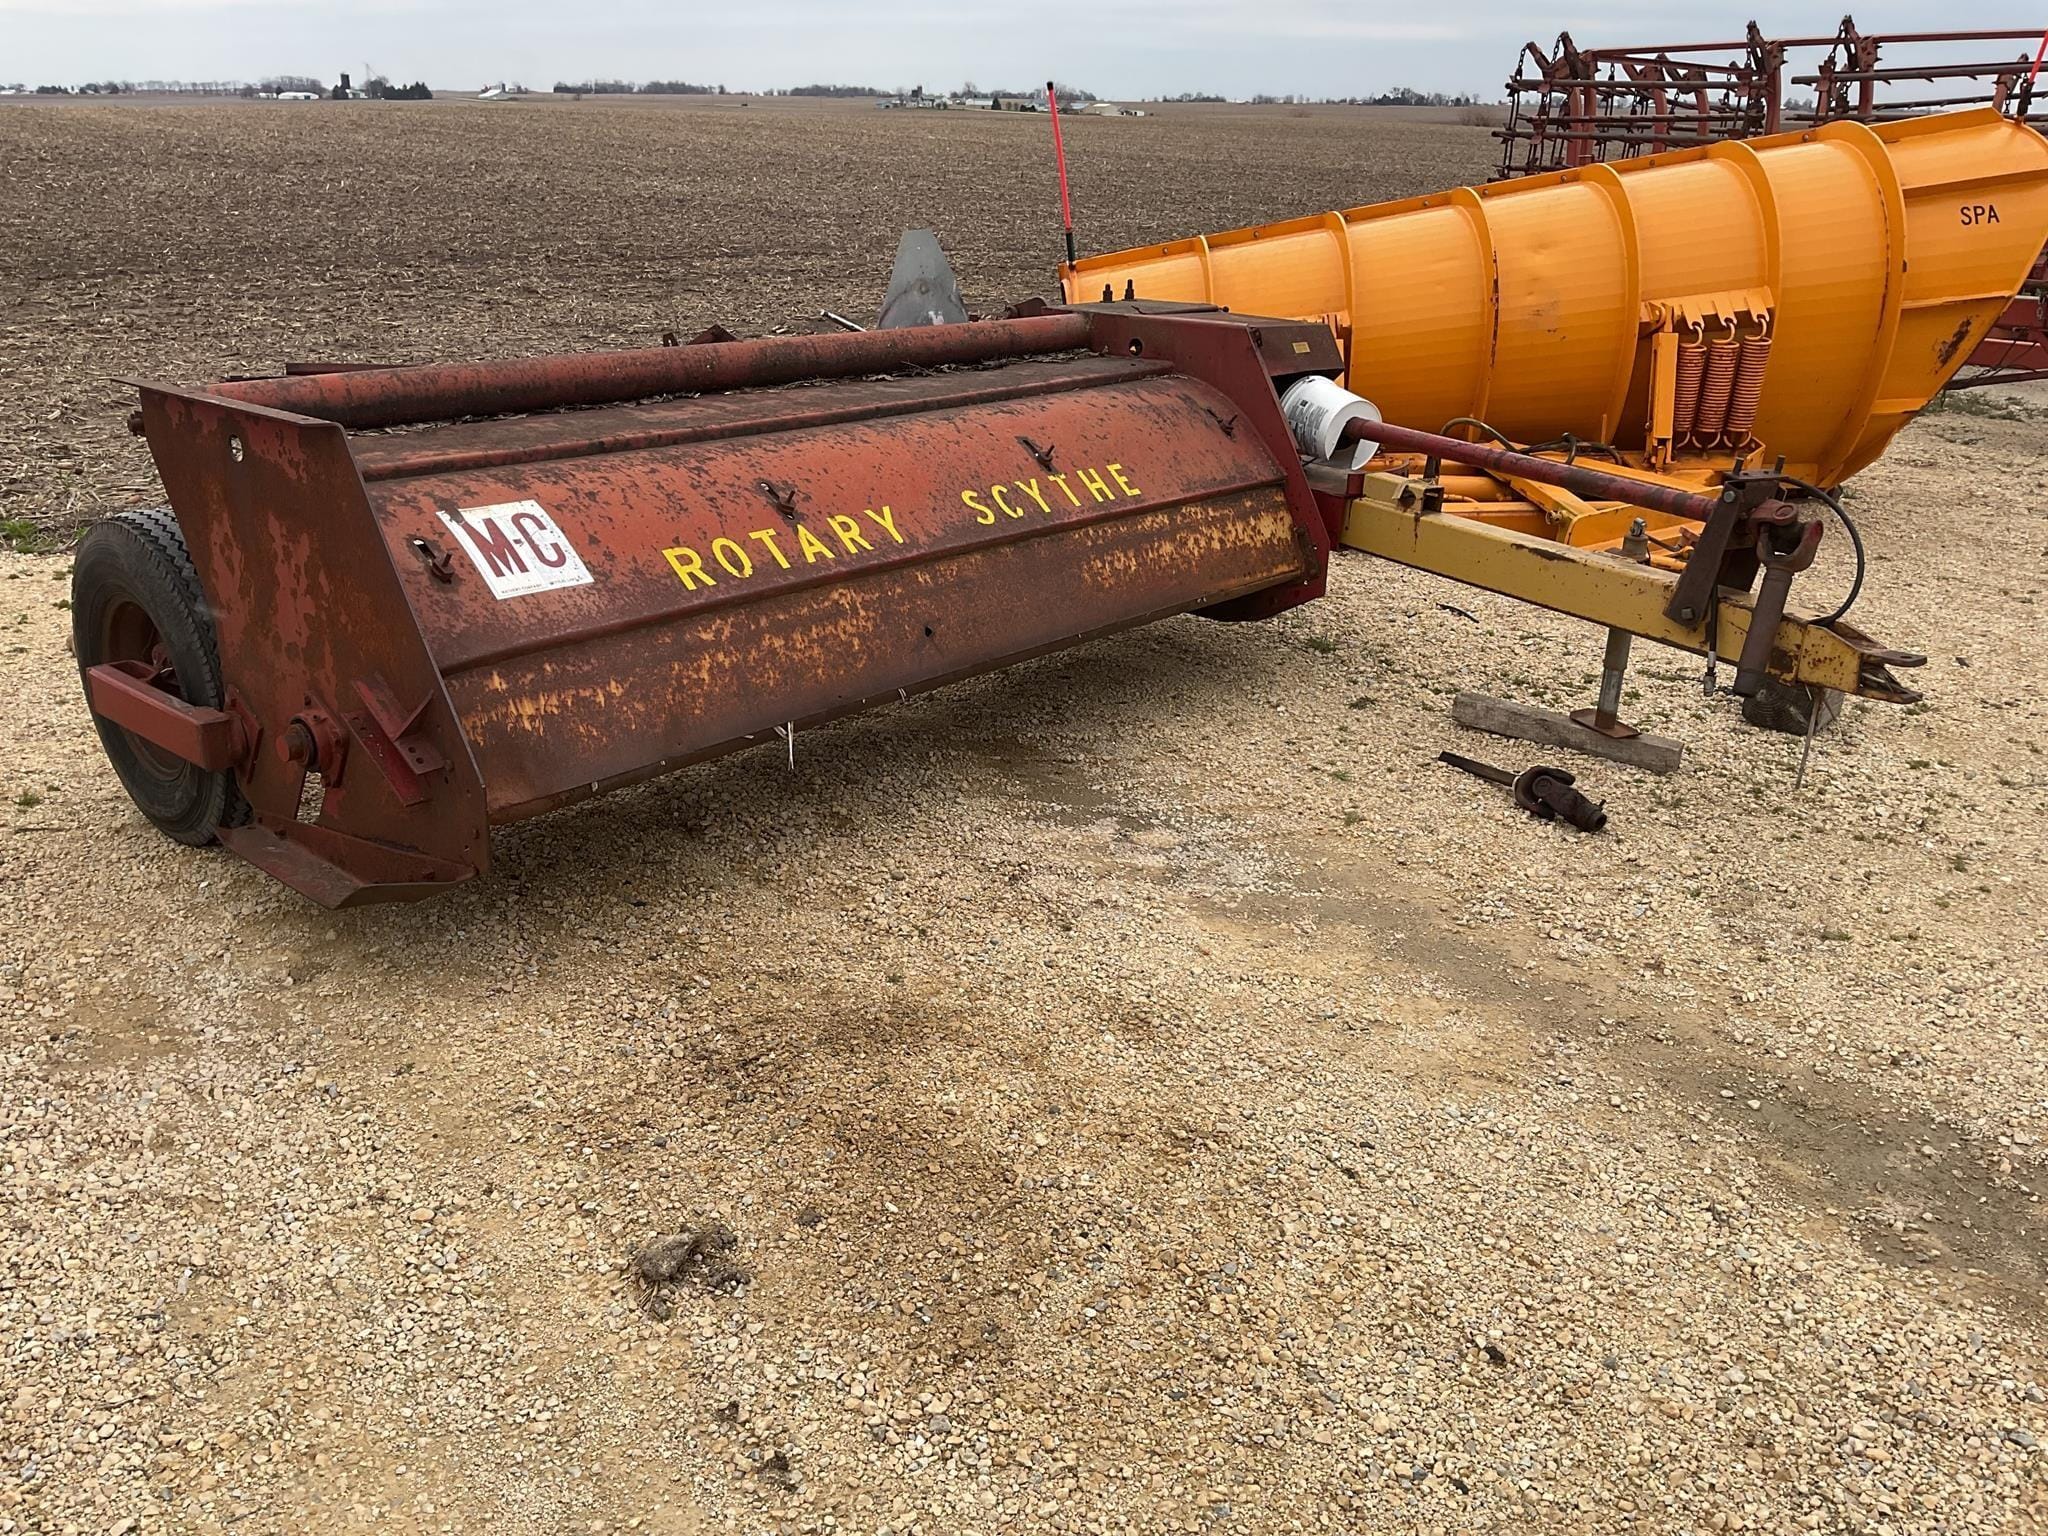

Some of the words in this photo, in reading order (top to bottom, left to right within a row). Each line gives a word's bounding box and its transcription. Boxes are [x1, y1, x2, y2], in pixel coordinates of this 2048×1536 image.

[1960, 205, 2000, 225] SPA
[461, 512, 567, 578] M-C
[662, 506, 904, 591] ROTARY
[961, 463, 1141, 526] SCYTHE
